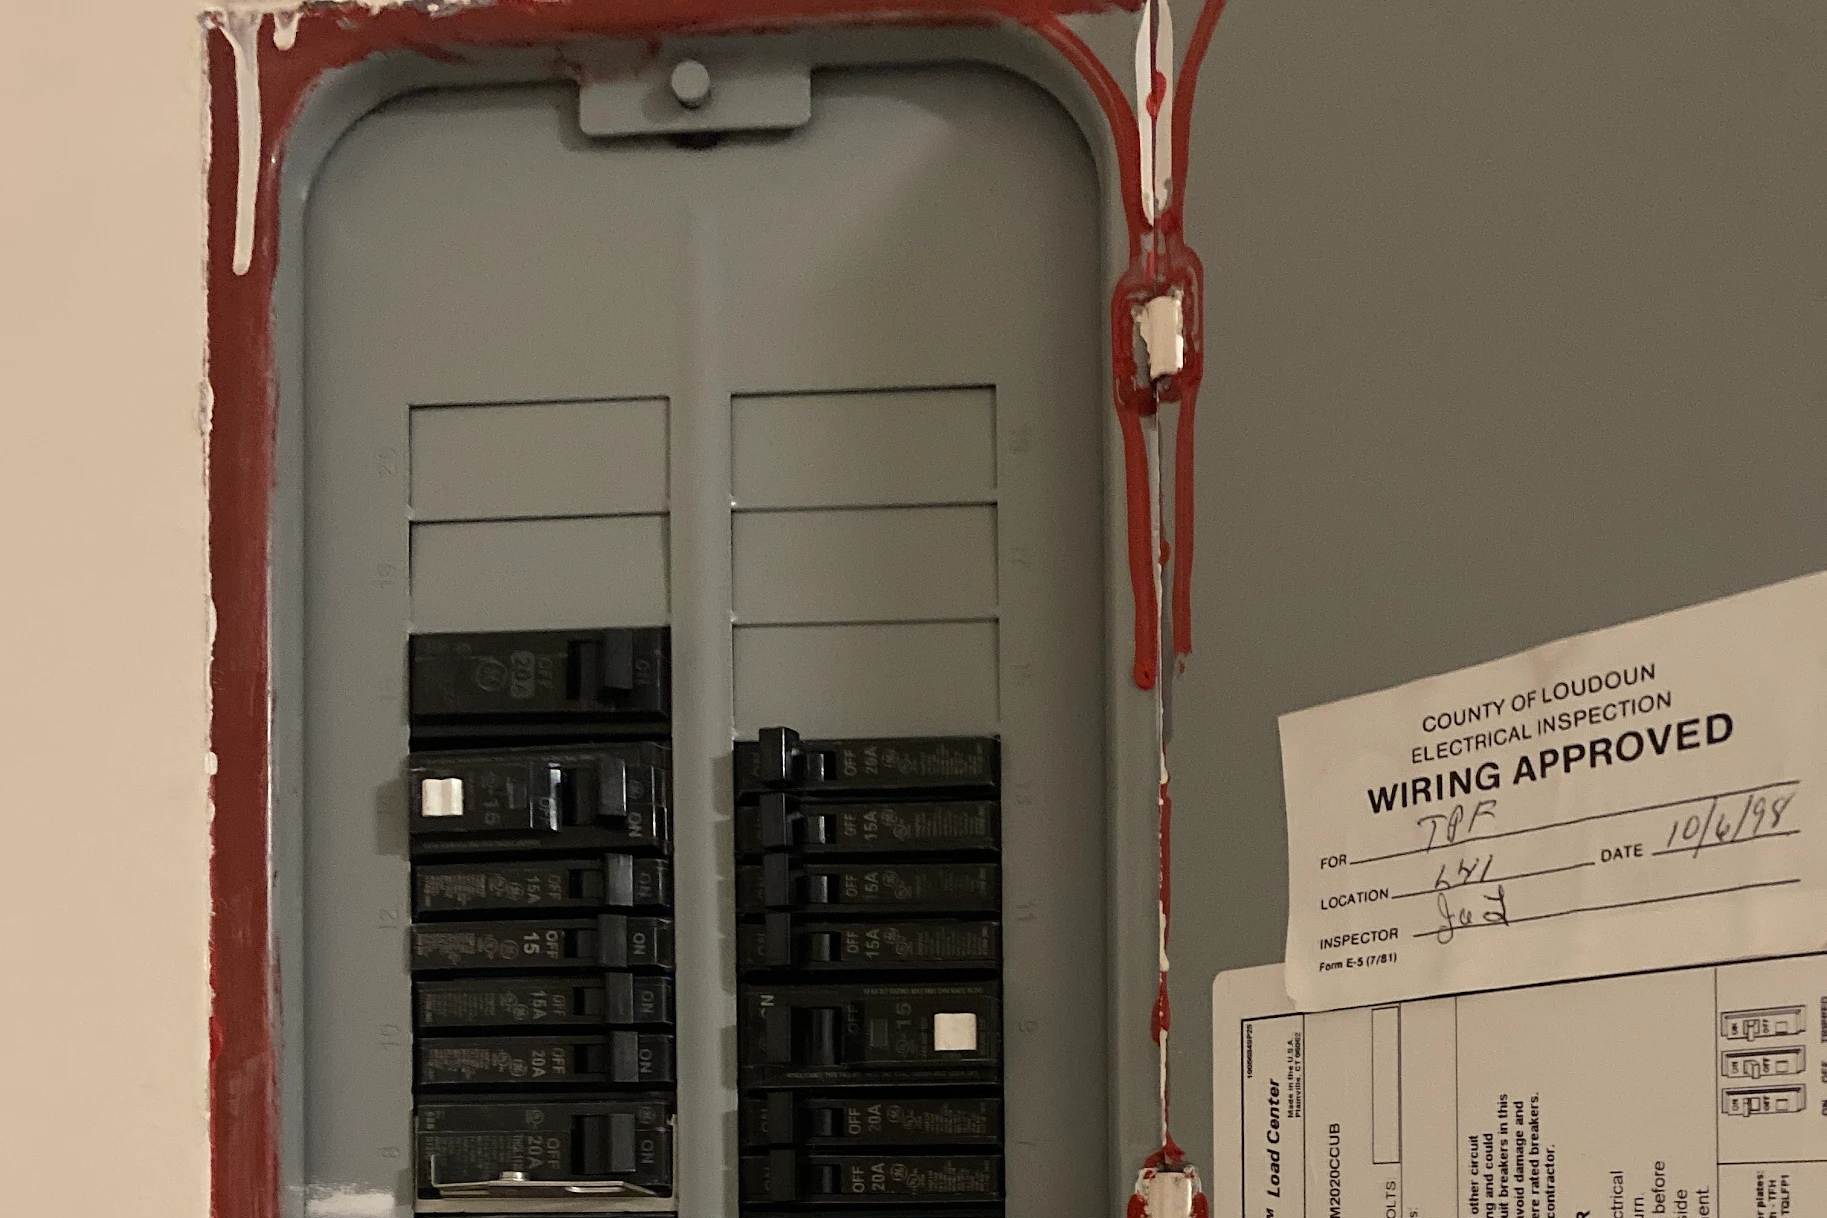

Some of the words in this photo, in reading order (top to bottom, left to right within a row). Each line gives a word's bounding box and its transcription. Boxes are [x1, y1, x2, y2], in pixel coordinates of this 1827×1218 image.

[1421, 698, 1507, 733] COUNTY
[1510, 690, 1539, 712] OF
[1541, 663, 1657, 704] LOUDOUN
[1410, 723, 1533, 764] ELECTRICAL
[1536, 691, 1673, 736] INSPECTION
[845, 749, 857, 776] OFF
[1367, 762, 1502, 814] WIRING
[1512, 711, 1735, 786] APPROVED
[1666, 791, 1795, 858] 10/6/98
[1320, 853, 1348, 870] FOR
[1600, 843, 1643, 863] DATE
[1320, 887, 1390, 911] LOCATION
[524, 932, 539, 954] 15
[545, 930, 558, 959] OFF
[632, 933, 646, 955] ON
[1319, 928, 1399, 950] INSPECTOR
[1318, 959, 1343, 972] Form
[1345, 957, 1363, 968] E-5
[1365, 951, 1397, 967] (7/81)
[897, 1002, 911, 1026] 15
[532, 1050, 546, 1077] 20A
[551, 1048, 565, 1074] OFF
[1265, 1078, 1280, 1145] Center
[527, 1136, 543, 1169] 20A
[545, 1137, 560, 1169] OFF
[1467, 1135, 1479, 1177] circuit
[1482, 1133, 1494, 1171] could
[853, 1166, 864, 1192] OFF
[872, 1162, 885, 1192] 20A
[1265, 1148, 1280, 1199] Load
[1482, 1173, 1494, 1199] and
[1650, 1161, 1666, 1215] before
[1467, 1179, 1480, 1216] other
